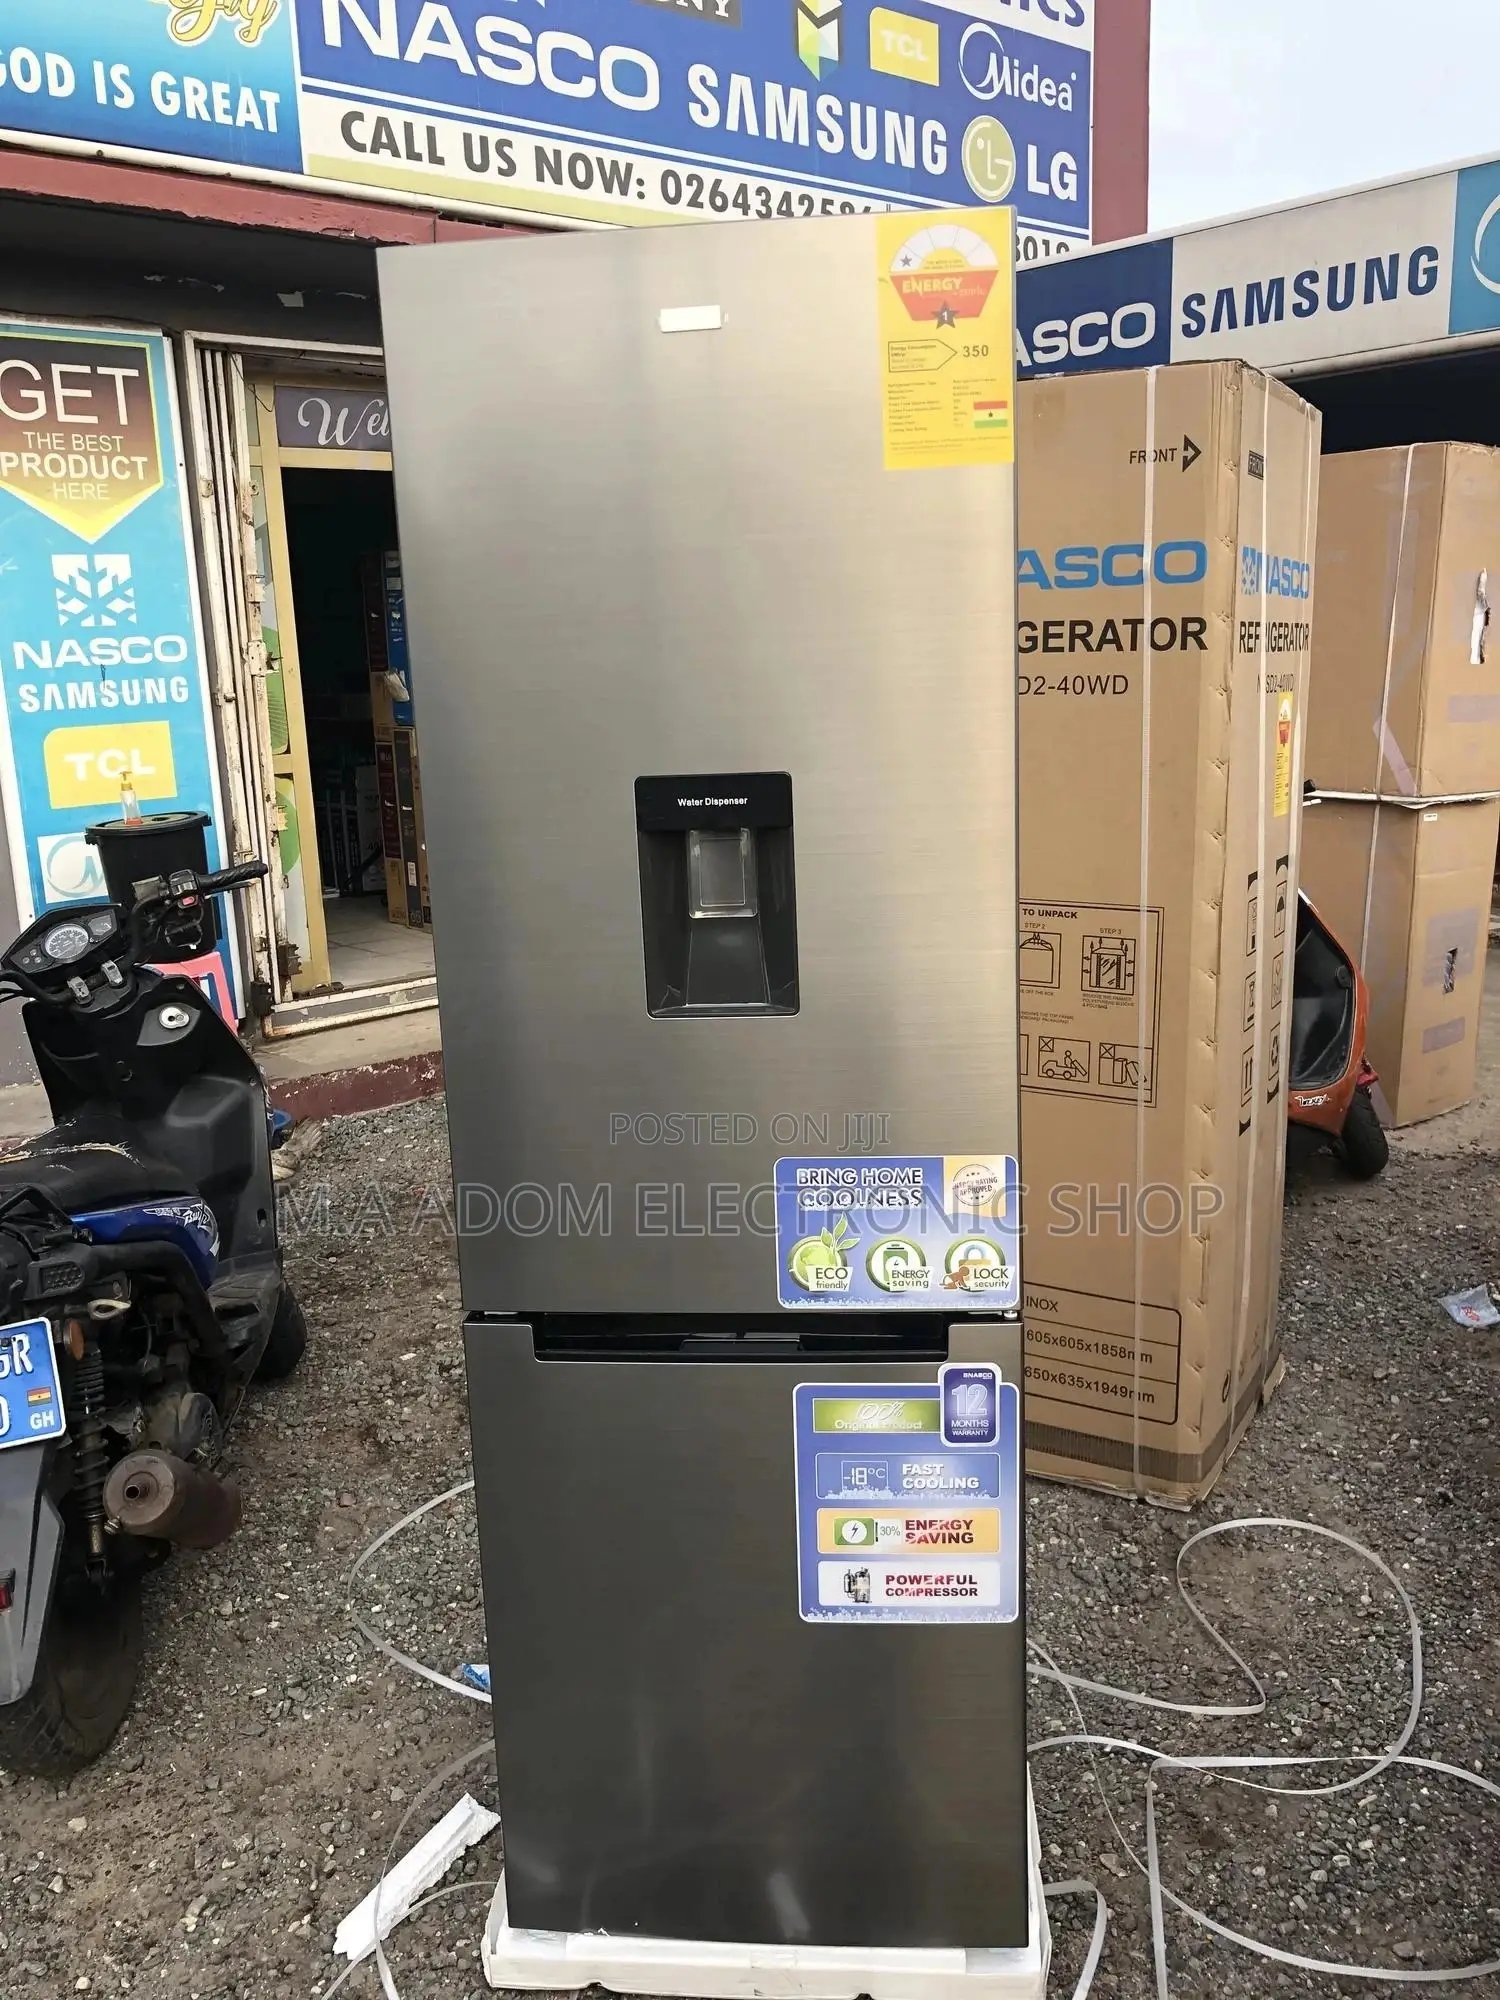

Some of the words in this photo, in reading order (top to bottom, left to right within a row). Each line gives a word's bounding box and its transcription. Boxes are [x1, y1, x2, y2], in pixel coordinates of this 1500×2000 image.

[323, 0, 660, 111] NASCO
[880, 27, 929, 64] TCL
[0, 46, 76, 98] OD
[93, 60, 135, 109] IS
[150, 70, 281, 133] GREAT
[687, 62, 948, 175] SAMSUNG
[340, 110, 446, 167] CALL
[462, 132, 518, 178] US
[535, 145, 646, 200] NOW:
[1027, 143, 1078, 202] LG
[902, 275, 963, 296] ENERGY
[1181, 245, 1440, 340] SAMSUNG
[942, 311, 948, 321] 1
[962, 344, 989, 358] 350
[0, 359, 140, 426] GET
[22, 430, 66, 451] THE
[72, 433, 124, 452] BEST
[1, 452, 148, 482] PRODUCT
[52, 481, 109, 501] HERE
[13, 634, 188, 670] NASCO
[19, 675, 190, 713] SAMSUNG
[64, 748, 157, 781] TCL
[677, 798, 704, 807] Water
[704, 796, 748, 807] Dispenser
[1022, 908, 1035, 916] TO
[1038, 909, 1078, 919] UNPACK
[797, 1167, 858, 1187] BRING
[862, 1167, 923, 1186] HOME
[799, 1187, 924, 1209] COOLNESS
[815, 1267, 848, 1280] ECO
[891, 1269, 930, 1279] ENERGY
[973, 1267, 1009, 1280] LOCK
[816, 1279, 849, 1291] friendly
[892, 1279, 930, 1289] saving
[974, 1279, 1010, 1290] security
[951, 1383, 988, 1416] 12
[30, 1410, 55, 1430] GH
[951, 1419, 990, 1428] MONTHS
[902, 1463, 944, 1476] FAST
[902, 1477, 980, 1490] COOLING
[880, 1525, 901, 1537] 30%
[905, 1519, 974, 1531] ENERGY
[905, 1532, 974, 1544] SAVING
[885, 1574, 978, 1586] POWERFUL
[885, 1587, 979, 1597] COMPRESSOR
